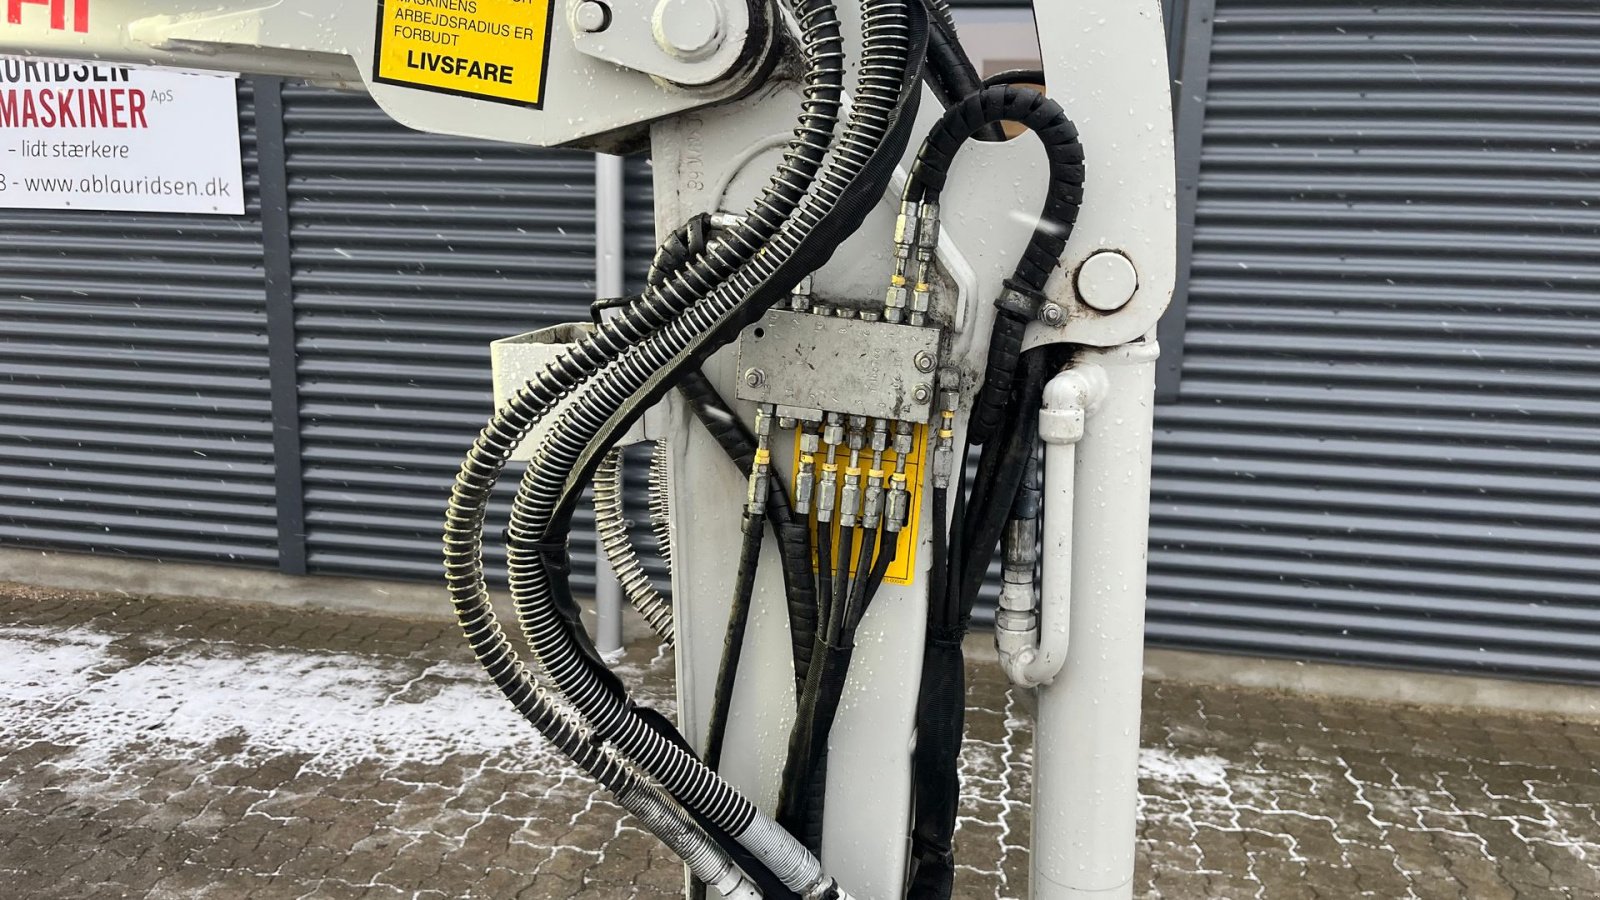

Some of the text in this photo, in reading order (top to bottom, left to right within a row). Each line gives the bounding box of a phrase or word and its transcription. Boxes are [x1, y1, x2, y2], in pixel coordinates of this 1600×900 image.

[397, 0, 477, 14] KINENS
[394, 25, 460, 46] FORBUDT
[395, 8, 533, 41] ARBEJDSRADIUS ER
[407, 50, 514, 84] LIVSFARE
[0, 88, 174, 128] MASKINER ApS
[22, 139, 48, 157] lidt
[52, 140, 129, 158] stærkere
[24, 174, 230, 197] www.ablauridsen.dk
